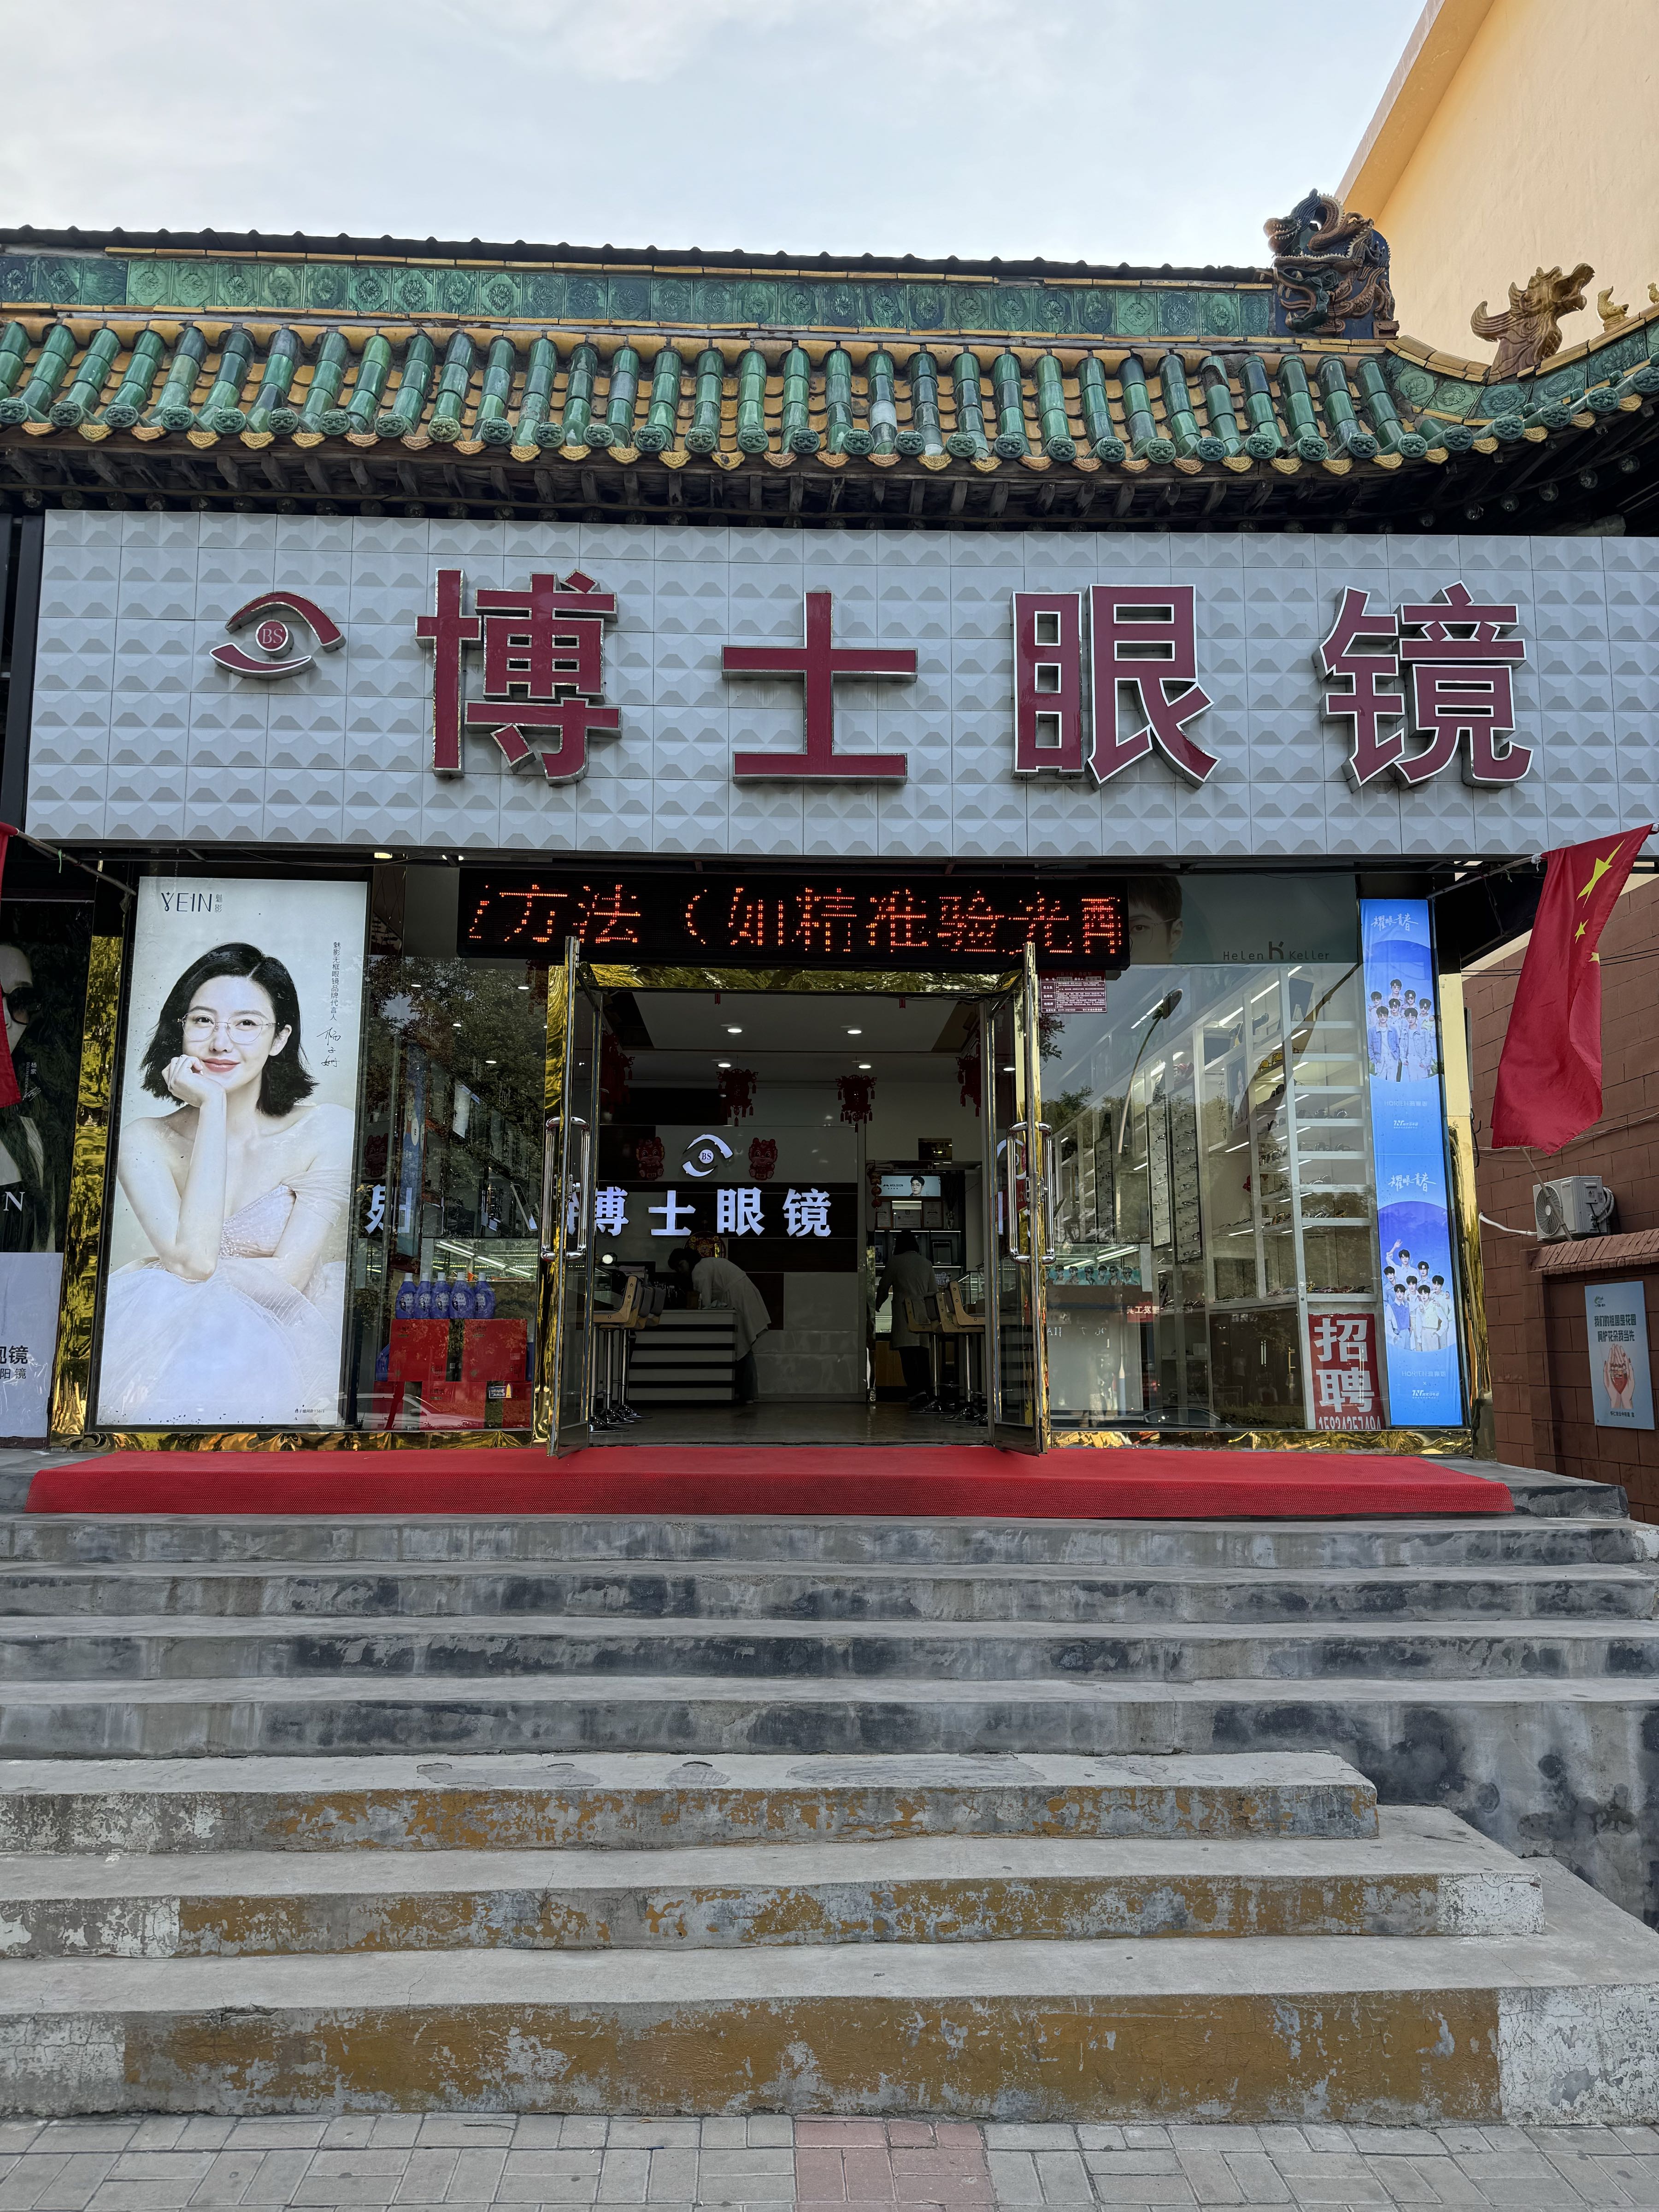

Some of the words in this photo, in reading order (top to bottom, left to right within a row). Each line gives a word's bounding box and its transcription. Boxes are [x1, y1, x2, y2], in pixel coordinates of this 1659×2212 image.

[262, 629, 283, 644] BS
[415, 568, 1534, 788] 博士眼镜
[161, 892, 212, 912] YEIN
[1371, 913, 1418, 931] 耀眼青春
[1223, 951, 1264, 960] Helen
[1289, 950, 1330, 960] Keller
[329, 941, 341, 1021] 魅影无框眼镜品牌代言人
[1388, 1172, 1436, 1192] 耀眼青春
[595, 1187, 831, 1237] 博士眼镜
[1594, 1314, 1636, 1327] 我们的祖国是花园
[1314, 1318, 1375, 1412] 招聘
